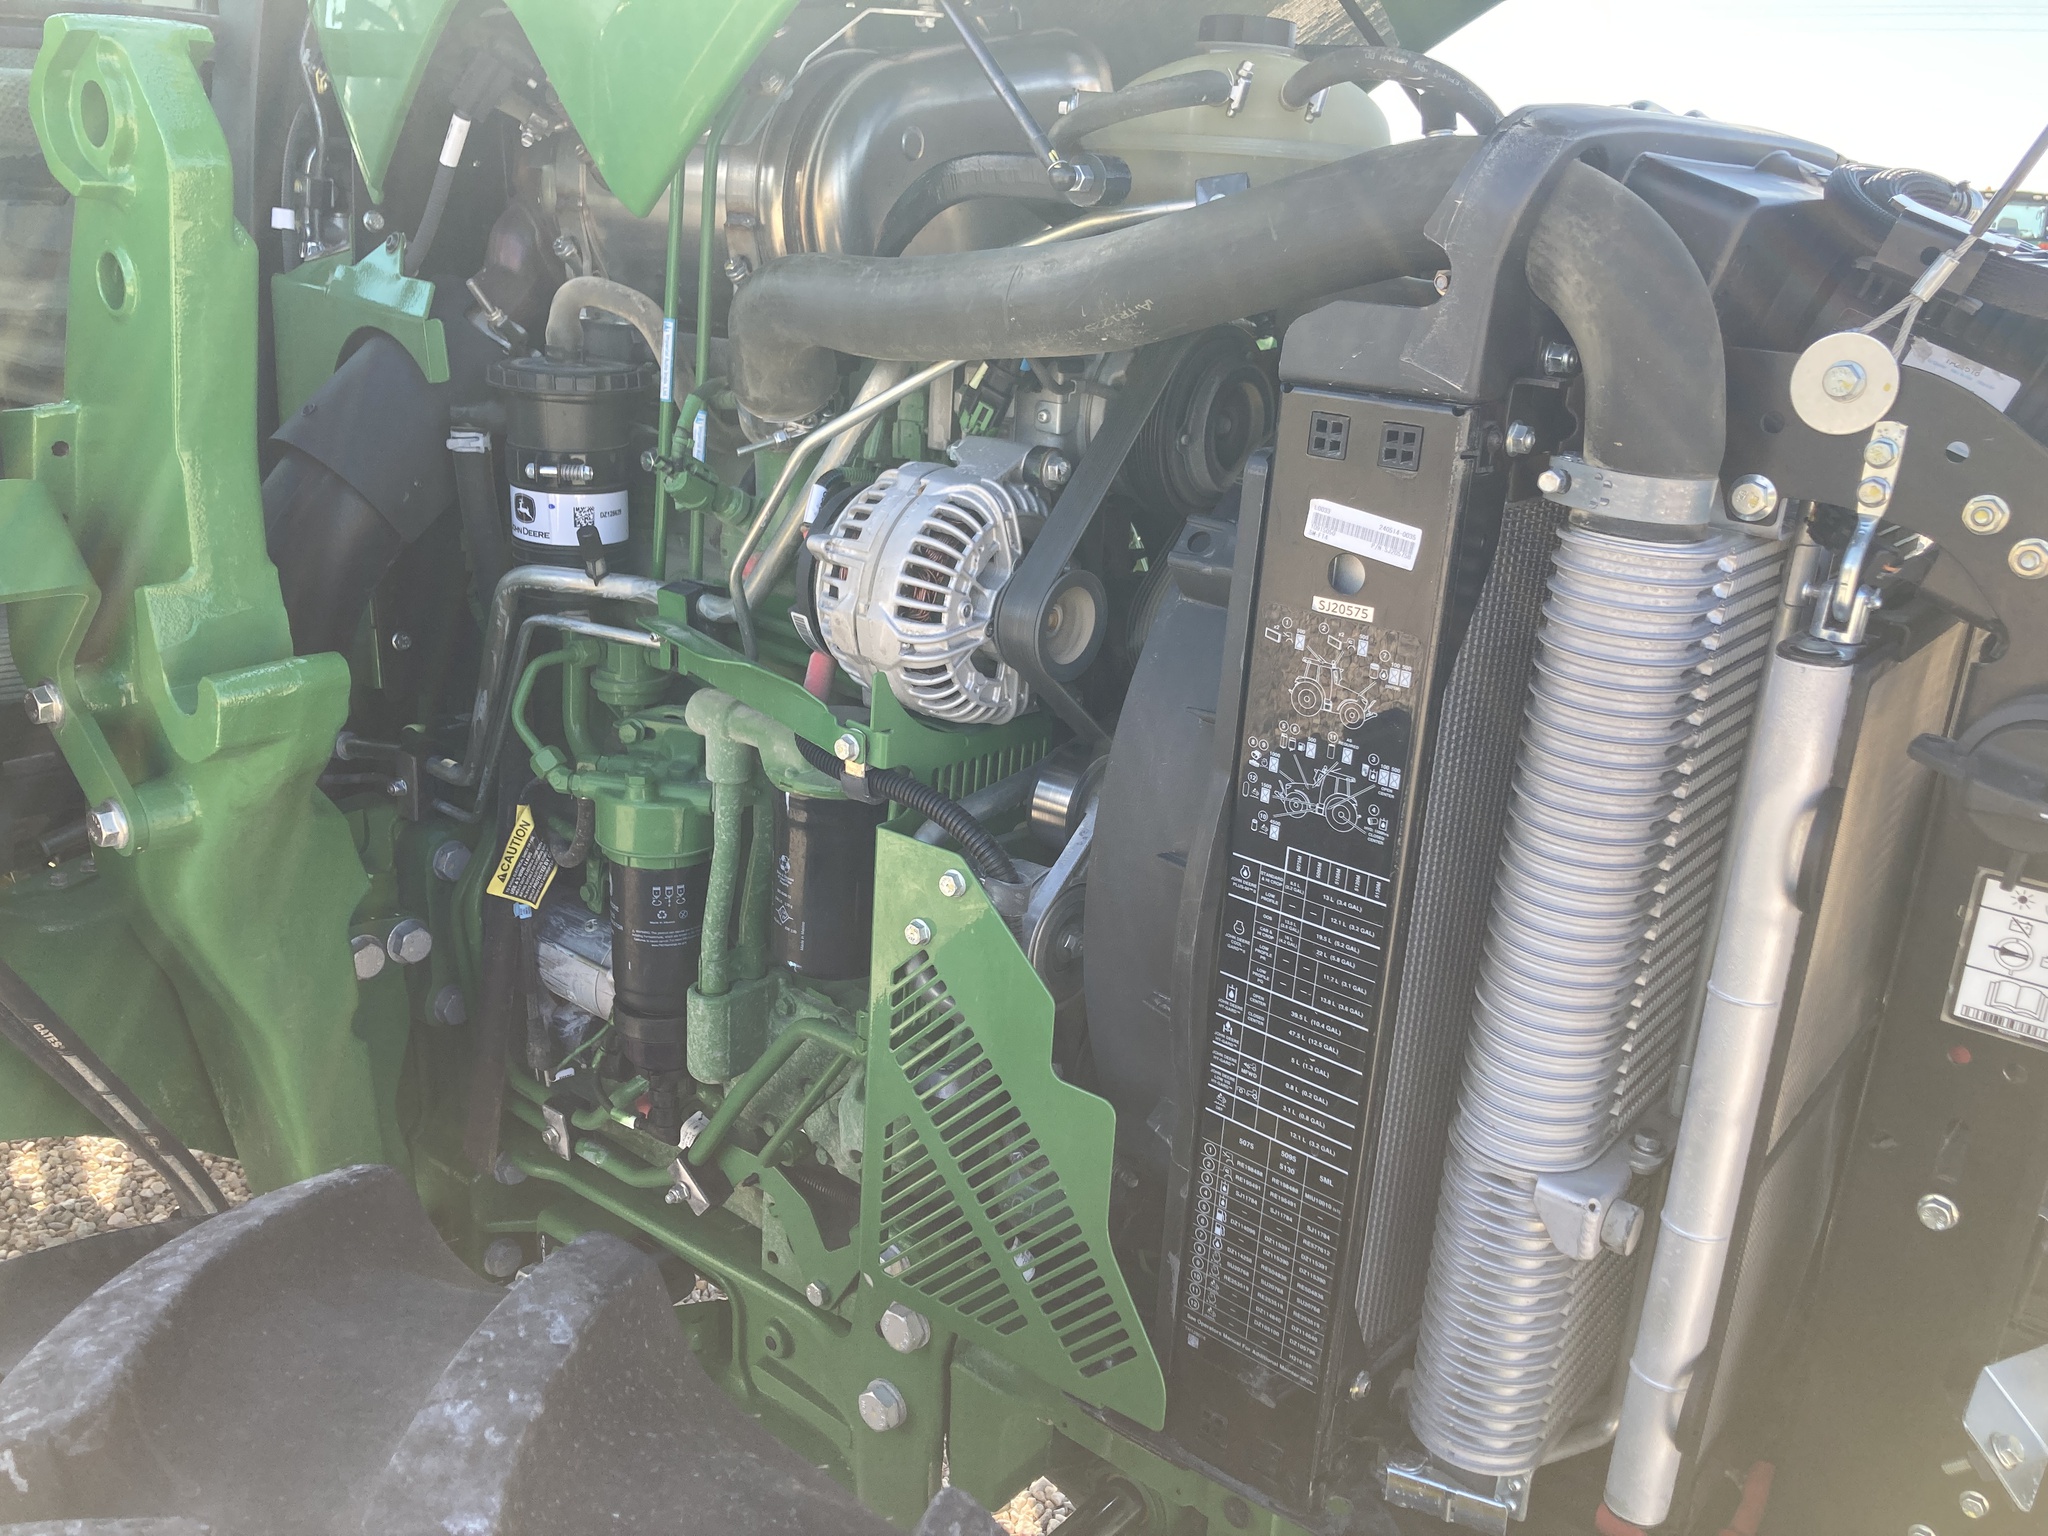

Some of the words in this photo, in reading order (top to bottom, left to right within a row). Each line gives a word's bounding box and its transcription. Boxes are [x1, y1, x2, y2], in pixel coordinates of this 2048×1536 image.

[523, 526, 550, 539] DEERE
[1379, 524, 1416, 540] 240514-0035
[1318, 600, 1368, 619] SJ20575
[1269, 818, 1280, 826] 4500
[500, 819, 531, 873] CAUTION
[1260, 870, 1283, 882] STANDARD
[1242, 880, 1257, 888] DEERE
[1260, 895, 1278, 905] PROFILE
[1265, 891, 1275, 899] LOW
[1336, 898, 1347, 907] (3.4
[1347, 902, 1362, 913] GAL)
[1259, 925, 1269, 933] CAB
[1330, 917, 1341, 925] 12.1
[1348, 923, 1359, 932] (3.2
[1359, 927, 1375, 938] GAL)
[1259, 944, 1268, 952] LOW
[1315, 933, 1326, 941] 19.5
[1333, 939, 1344, 949] (5.2
[1344, 943, 1360, 954] GAL)
[1254, 947, 1272, 958] PROFILE
[1340, 958, 1355, 969] GAL)
[1251, 970, 1269, 981] PROFILE
[1256, 967, 1266, 975] LOW
[1322, 973, 1334, 982] 11.7
[1340, 980, 1351, 990] (3.1
[1351, 984, 1367, 995] GAL)
[1249, 996, 1266, 1007] CENTER
[1252, 993, 1264, 1001] OPEN
[1247, 1010, 1264, 1021] CLOSED
[1348, 1006, 1364, 1018] GAL)
[1246, 1015, 1264, 1026] CENTER
[1290, 1010, 1302, 1020] 39.5
[1325, 1024, 1341, 1037] GAL)
[1288, 1029, 1300, 1038] 47.5
[1307, 1037, 1322, 1049] (12.5
[1322, 1043, 1339, 1056] GAL)
[1240, 1067, 1257, 1079] MFWD
[1302, 1061, 1313, 1072] (1.3
[1313, 1066, 1329, 1079] GAL)
[1301, 1088, 1312, 1099] (0.2
[1312, 1094, 1328, 1106] GAL)
[1282, 1105, 1290, 1113] 3.1
[1309, 1117, 1325, 1129] GAL)
[1238, 1137, 1254, 1149] 5075
[1289, 1131, 1300, 1140] 12.1
[1308, 1139, 1319, 1150] (3.2
[1320, 1144, 1336, 1157] GAL)
[1280, 1150, 1296, 1163] 5095
[1278, 1162, 1295, 1175] 5130
[1319, 1175, 1334, 1187] 5ML
[1186, 1312, 1196, 1322] See
[1222, 1332, 1241, 1347] Manual
[1241, 1343, 1250, 1352] For
[1251, 1348, 1278, 1368] Additional
